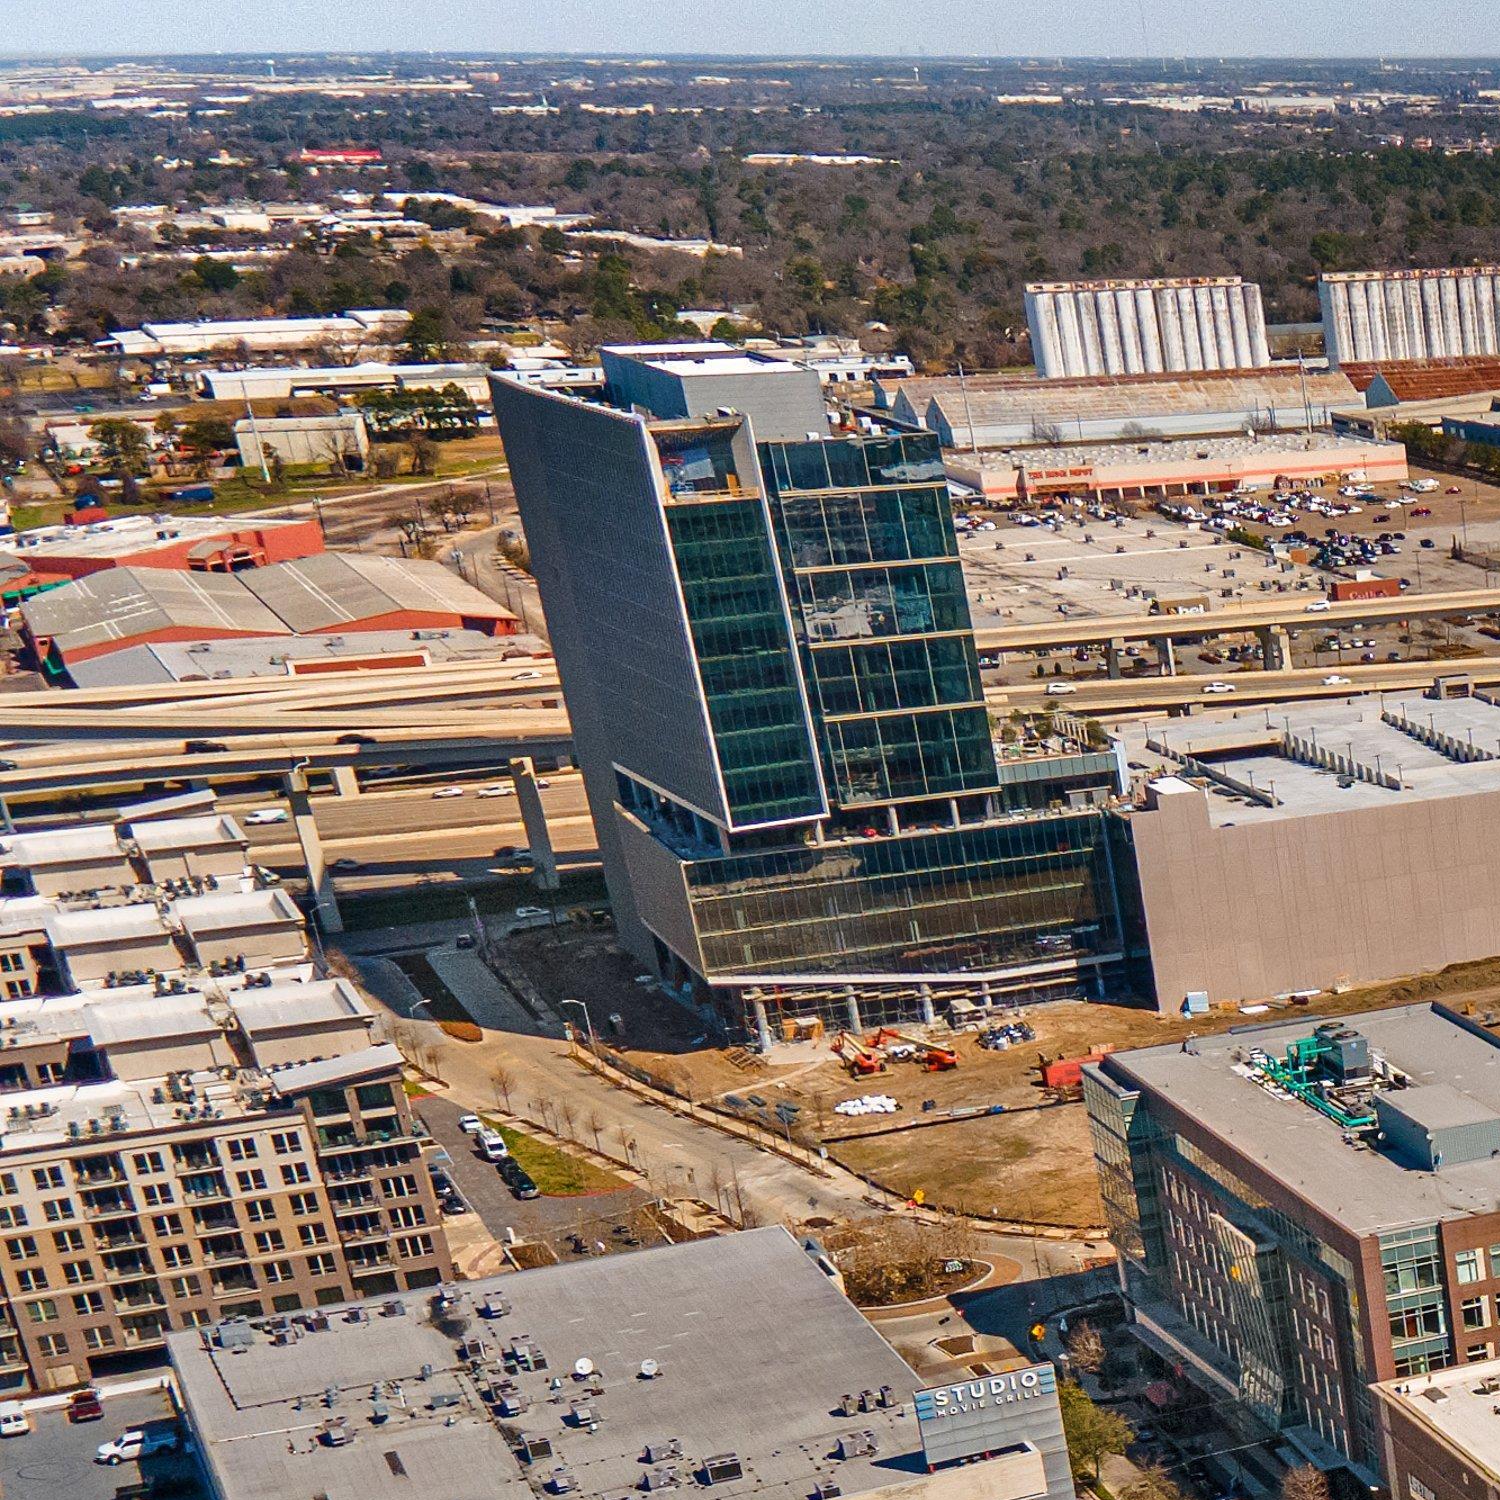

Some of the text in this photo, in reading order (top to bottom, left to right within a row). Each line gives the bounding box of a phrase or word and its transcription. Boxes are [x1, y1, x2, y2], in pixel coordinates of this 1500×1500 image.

[934, 1371, 1038, 1407] STUDIO
[936, 1389, 1041, 1419] MOVIE GRILL
